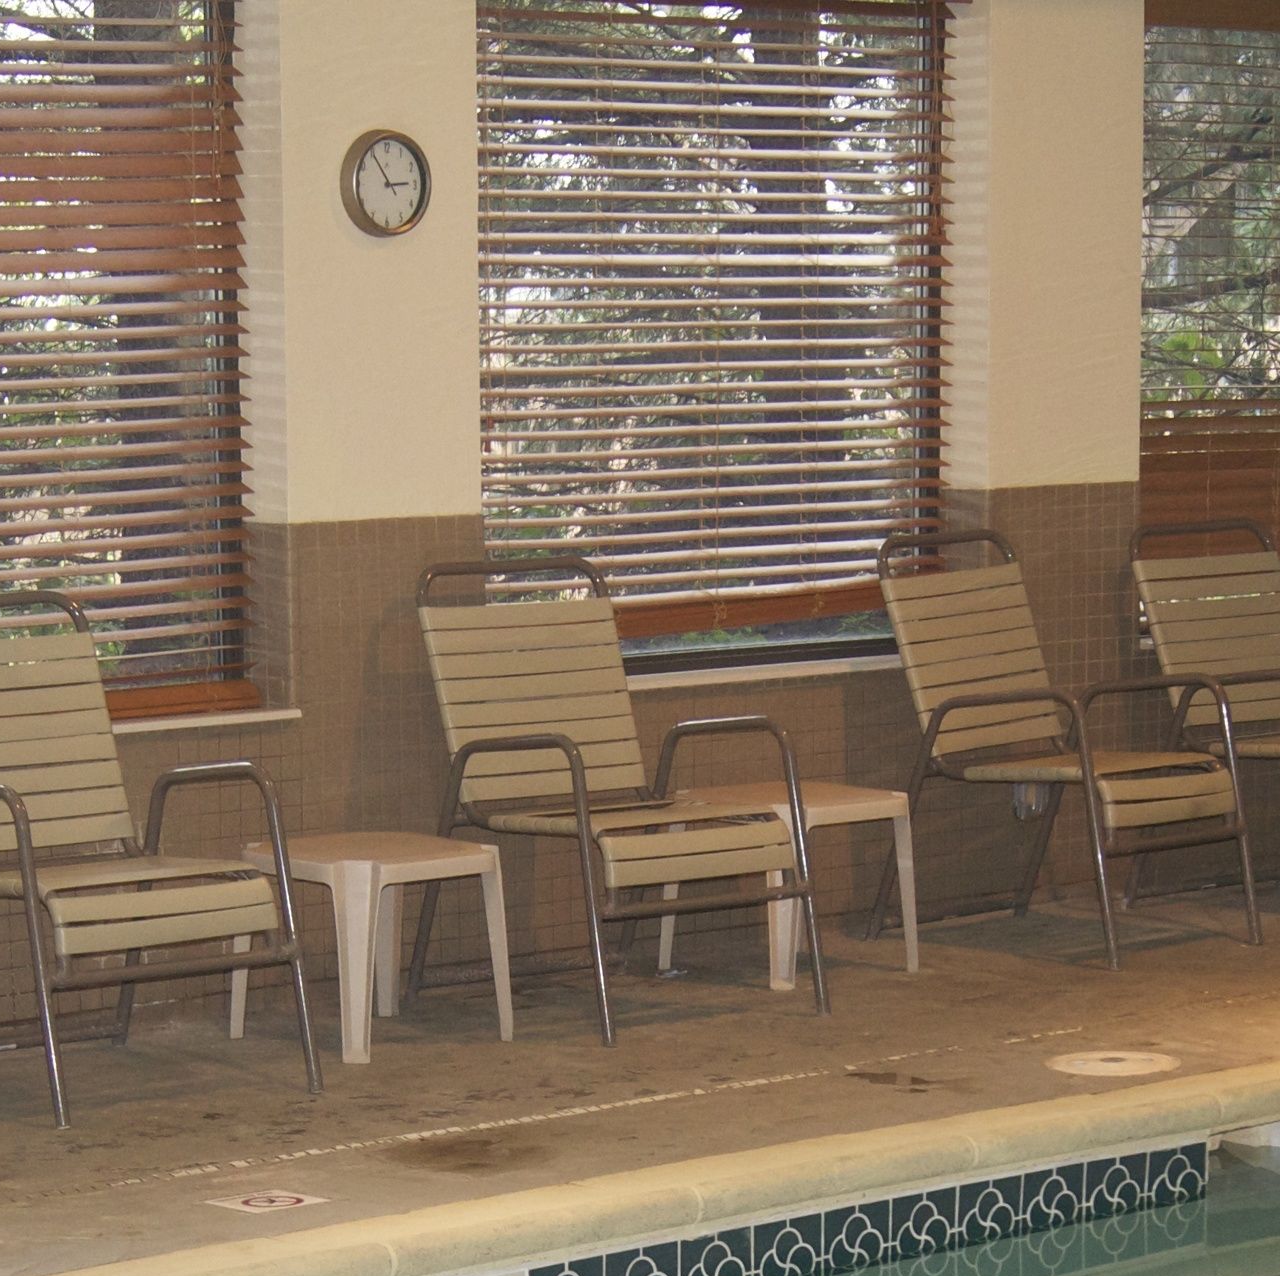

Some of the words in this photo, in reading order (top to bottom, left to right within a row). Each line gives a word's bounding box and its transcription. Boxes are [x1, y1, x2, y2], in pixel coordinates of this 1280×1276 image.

[384, 142, 391, 153] 12
[410, 162, 414, 172] 2
[413, 180, 417, 190] 3
